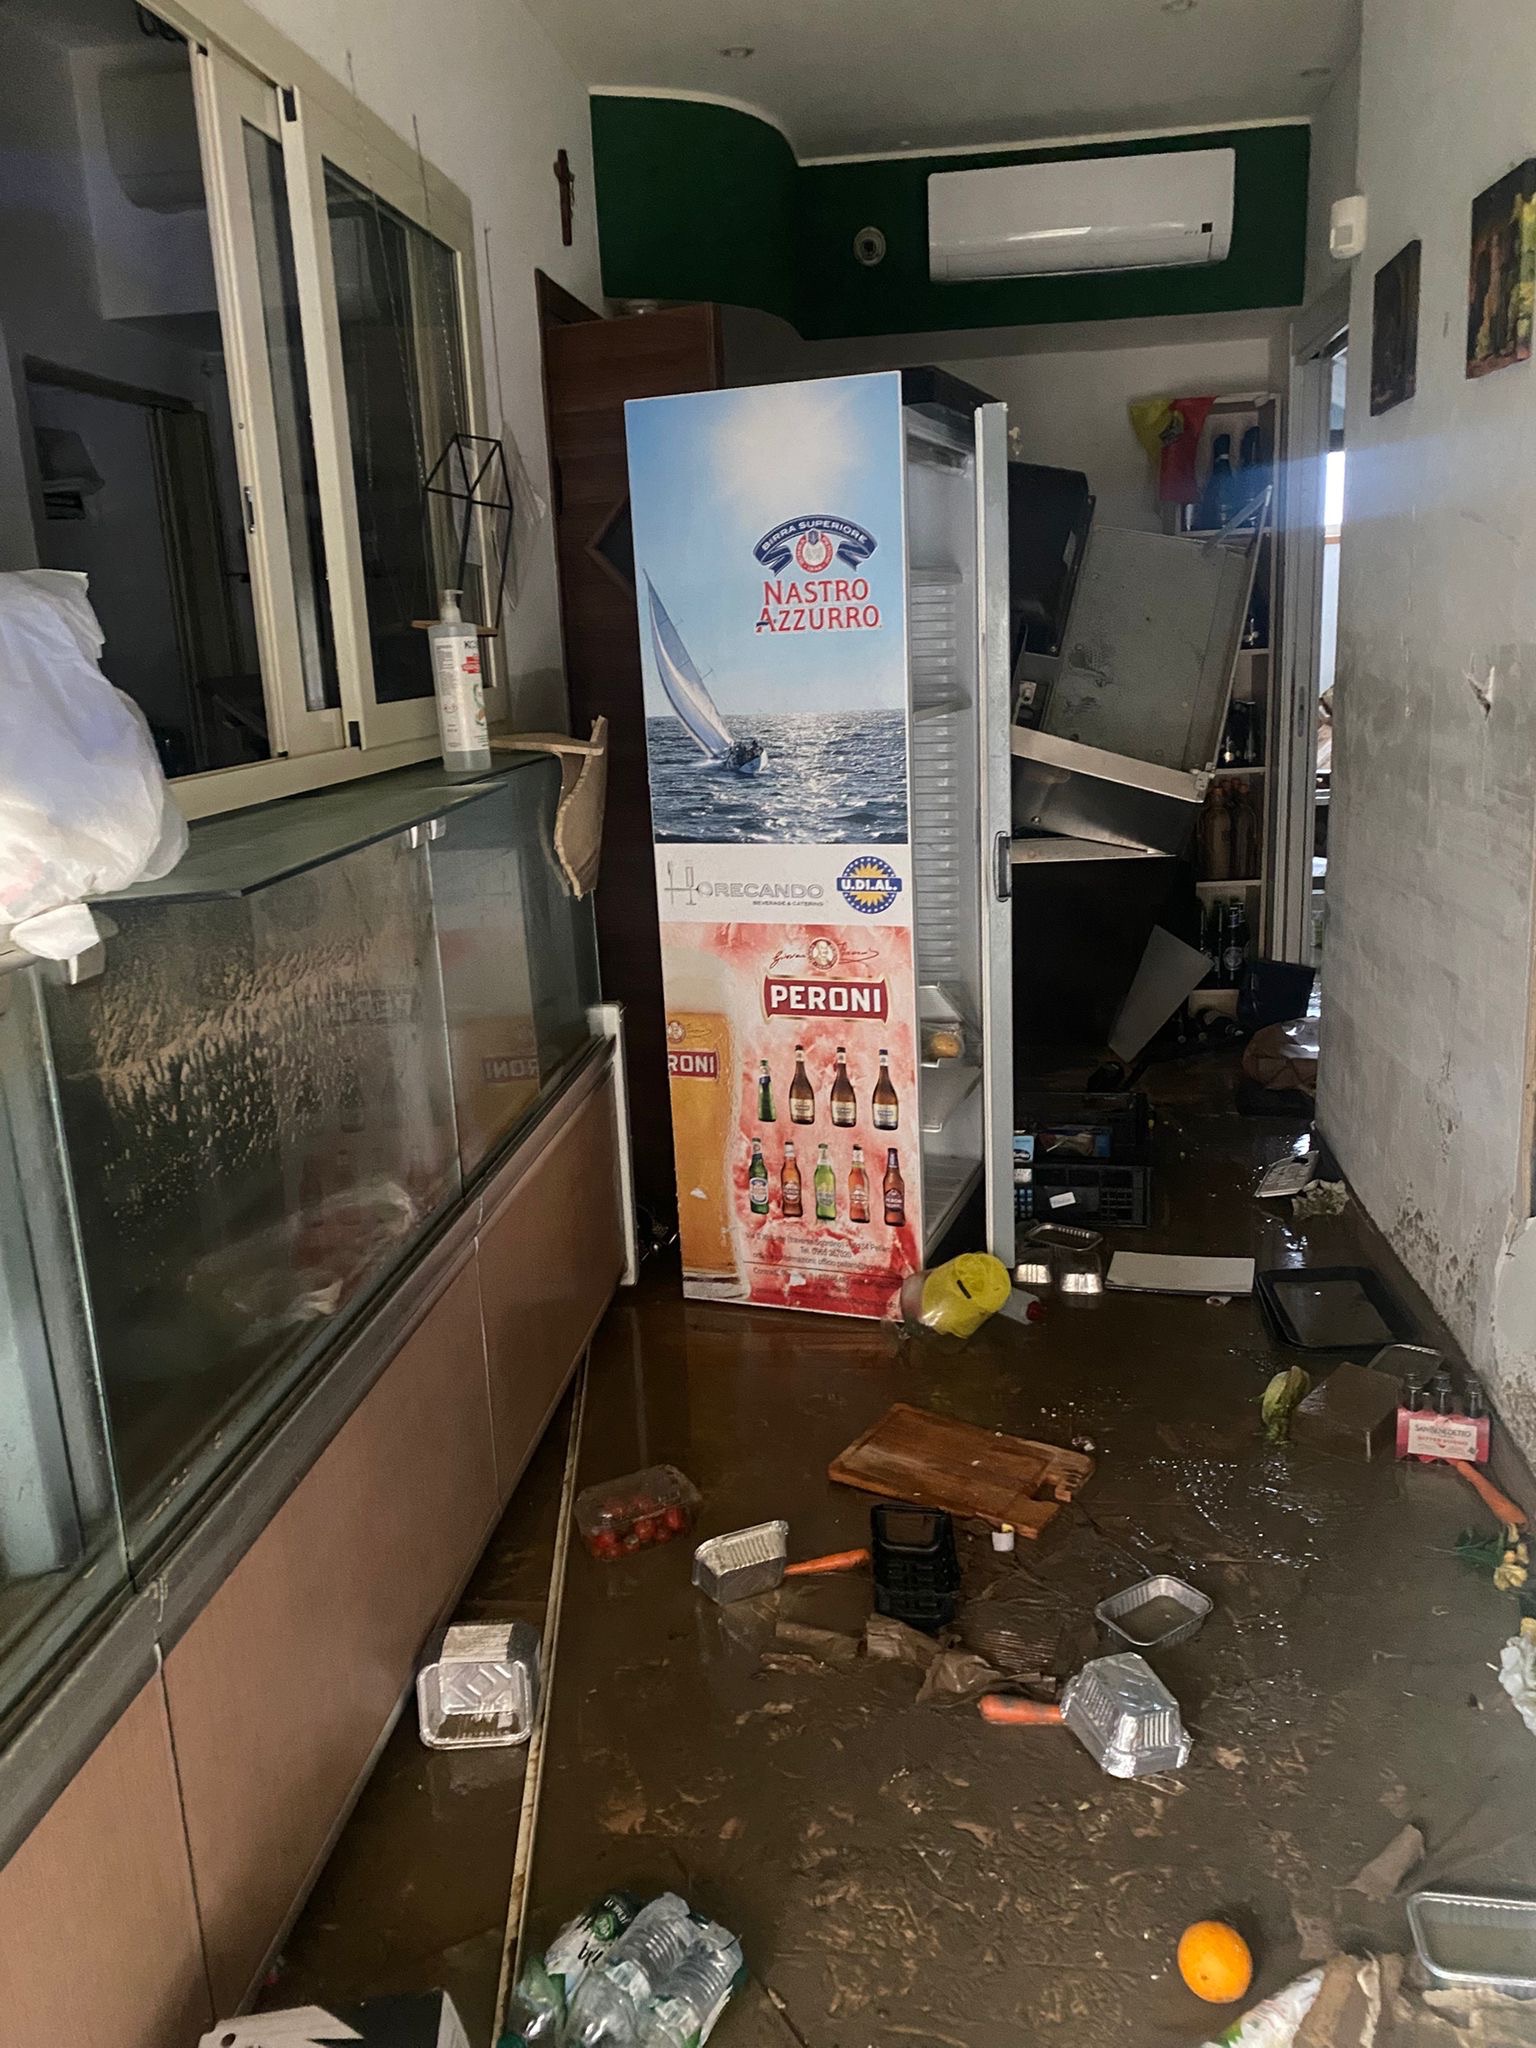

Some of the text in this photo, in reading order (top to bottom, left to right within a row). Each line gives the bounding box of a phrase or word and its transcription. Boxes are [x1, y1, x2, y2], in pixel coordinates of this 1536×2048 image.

[761, 519, 869, 551] BIRRA SUPERIORE
[763, 577, 869, 606] NASTRO
[755, 605, 880, 633] AZZURRO
[840, 878, 898, 891] U.DI.AL.
[770, 983, 882, 1013] PERONI
